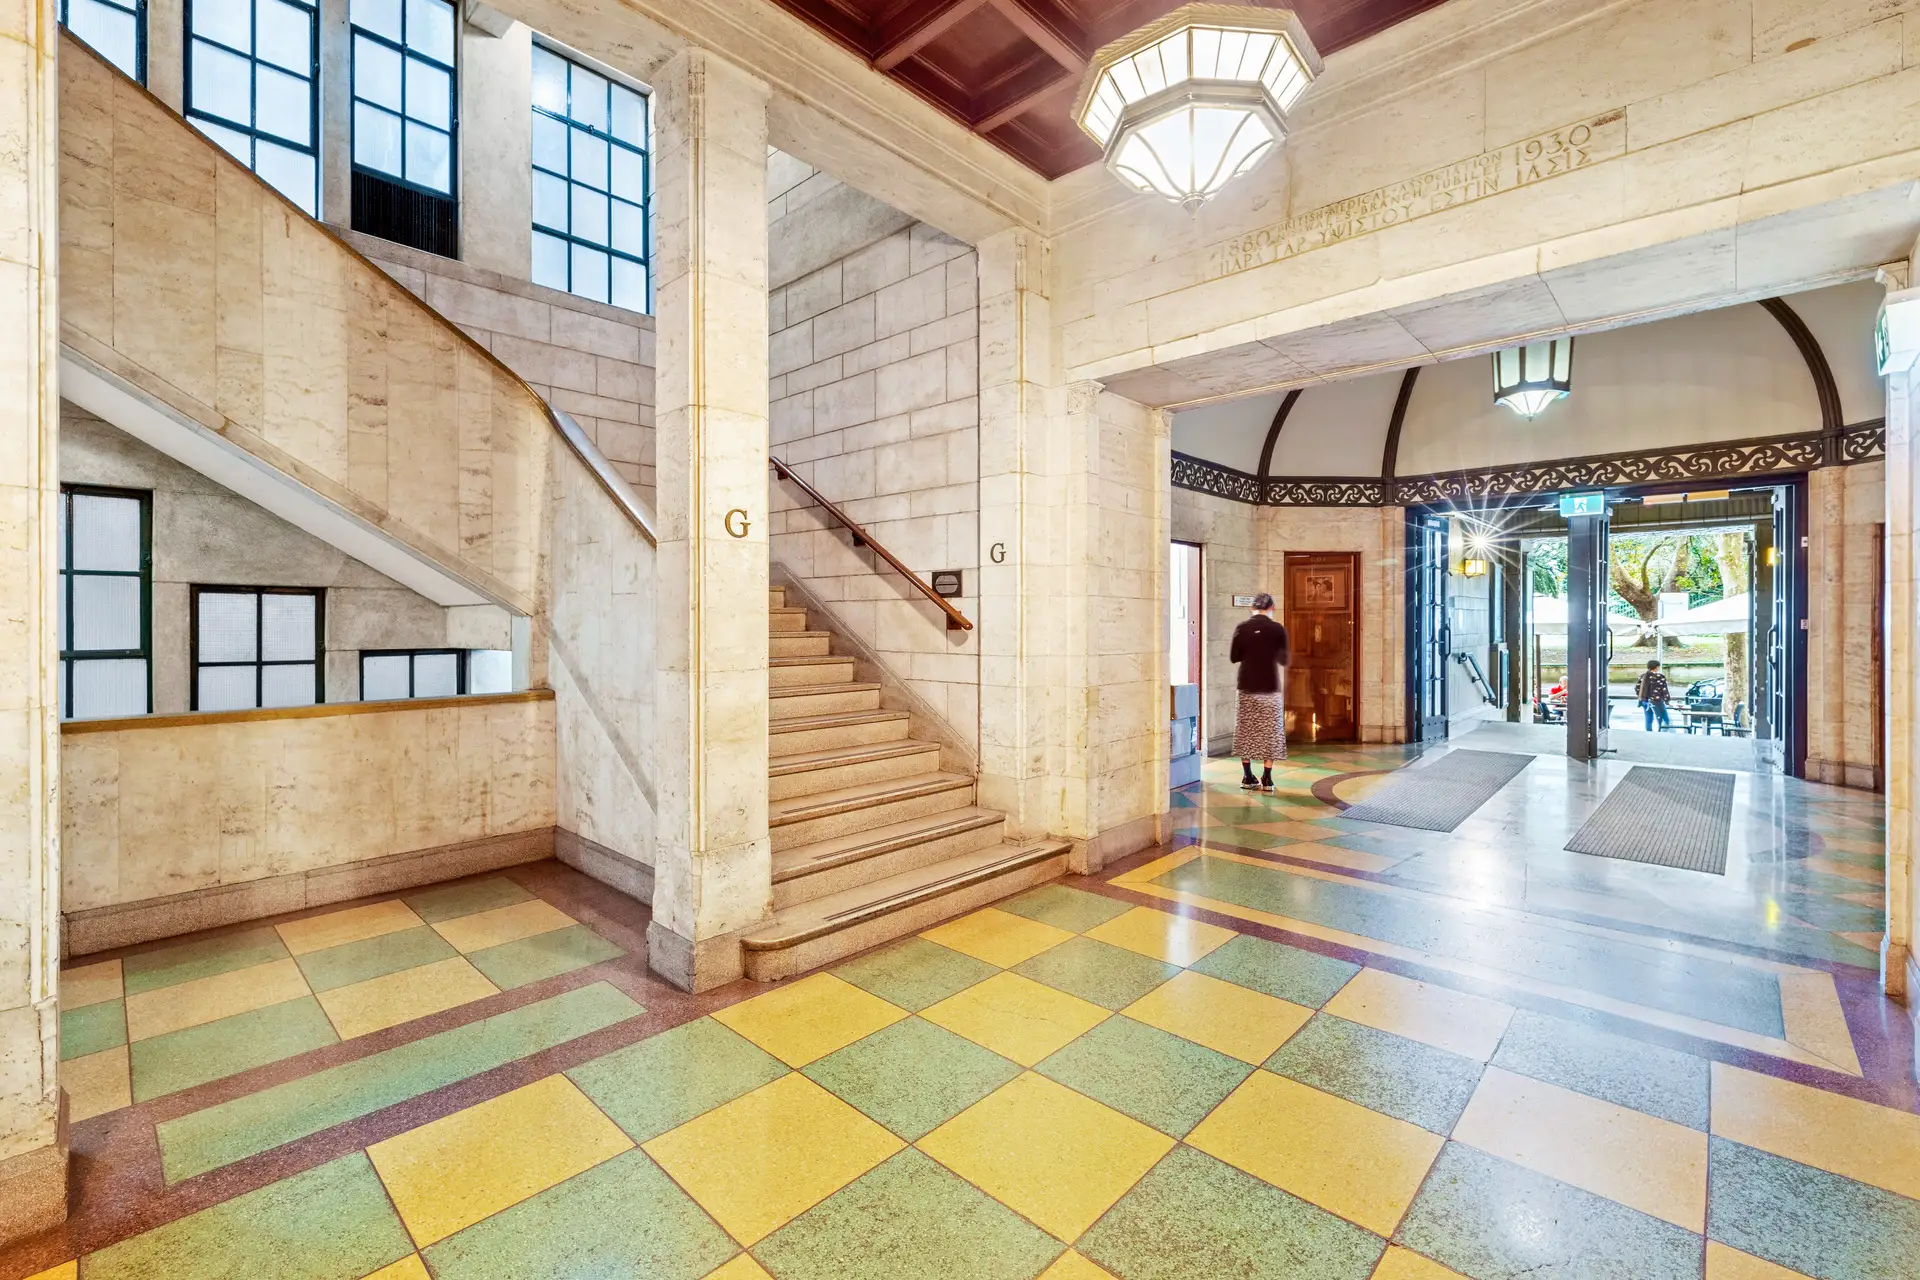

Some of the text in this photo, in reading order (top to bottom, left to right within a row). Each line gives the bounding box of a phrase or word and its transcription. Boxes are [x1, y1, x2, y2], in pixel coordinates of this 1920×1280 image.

[1516, 124, 1592, 166] 1930
[1277, 150, 1502, 232] BRITISH MEDICAL ASSOCIATION
[1361, 187, 1422, 216] BRANCH
[1436, 162, 1503, 190] JUBILEE
[1220, 229, 1271, 260] 1880
[724, 508, 752, 539] G
[990, 542, 1007, 564] G
